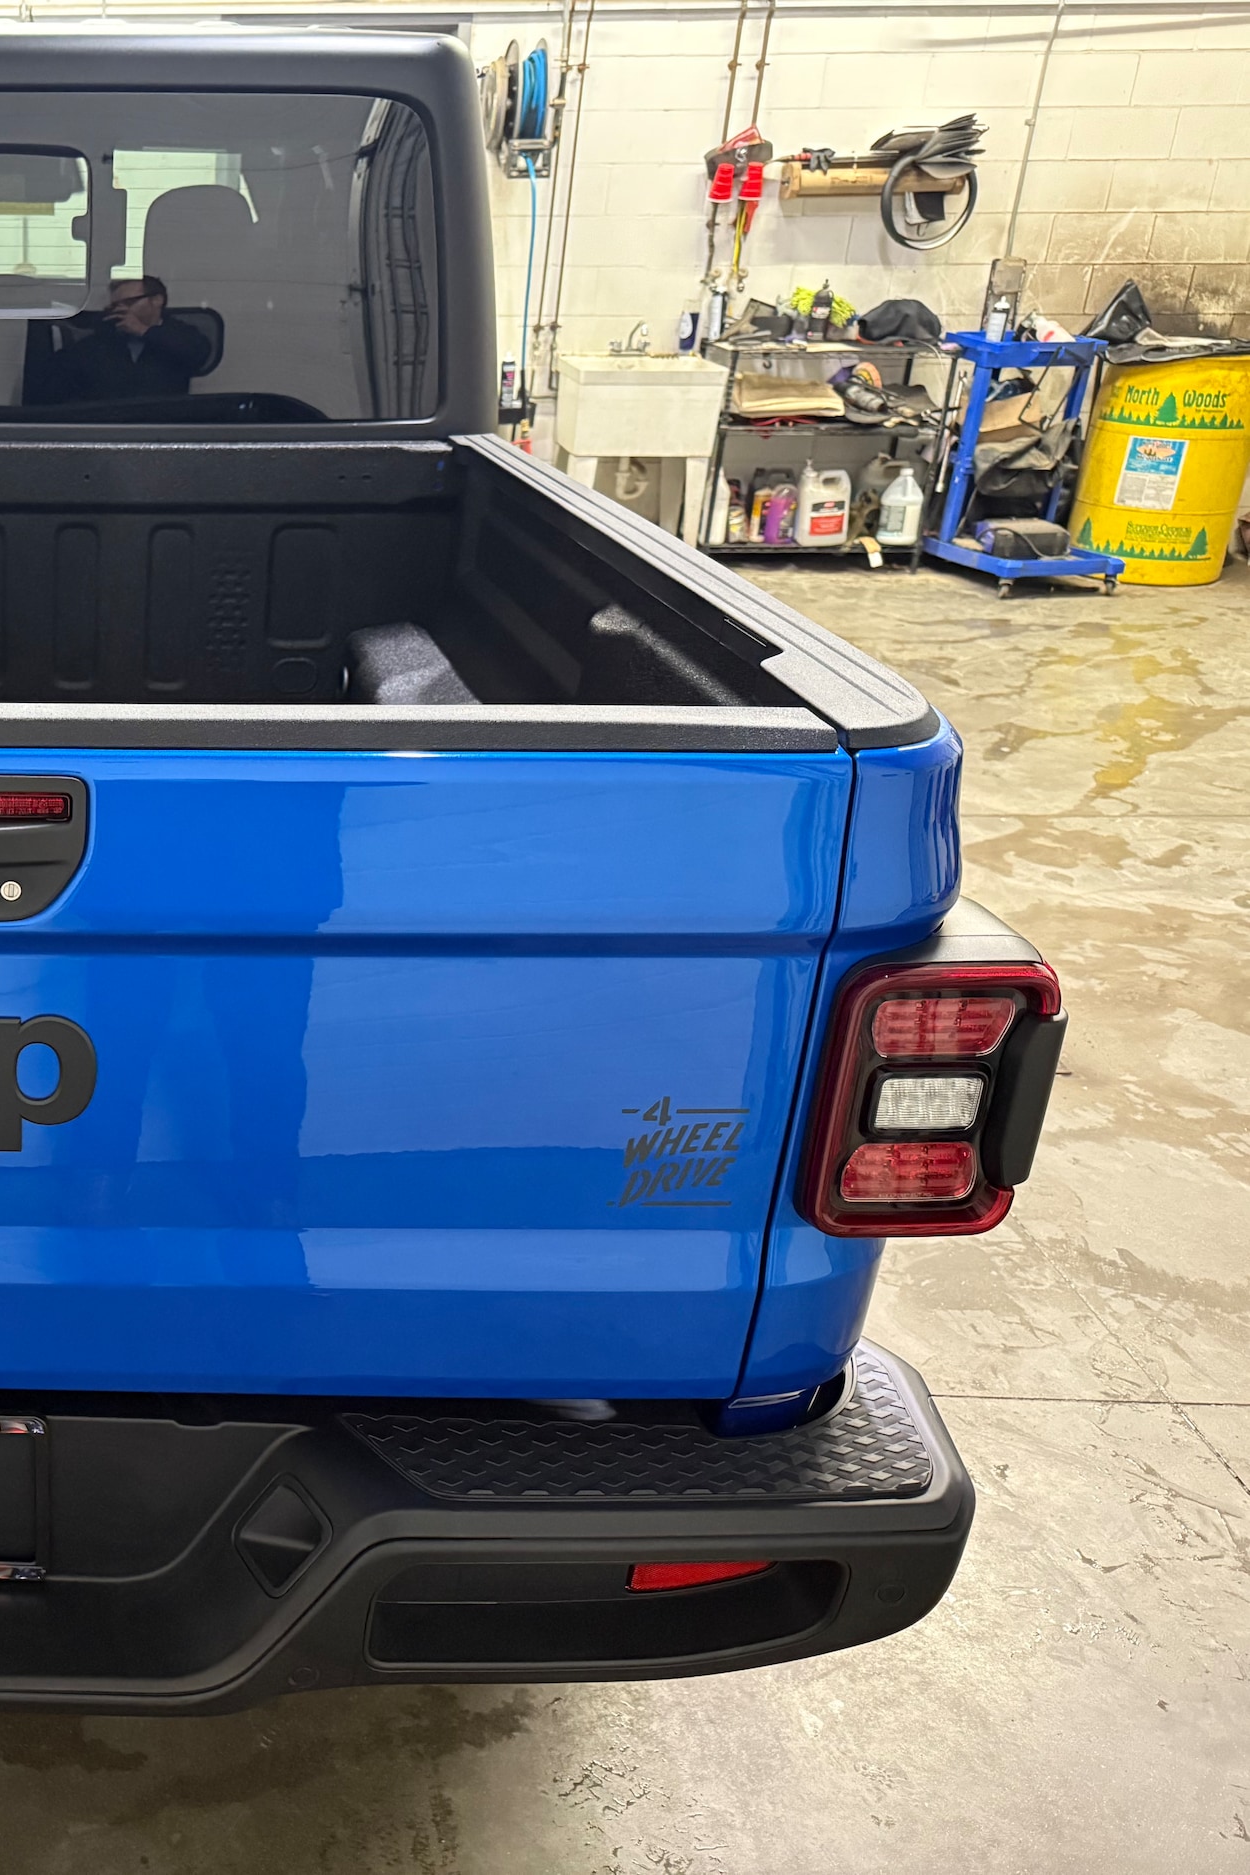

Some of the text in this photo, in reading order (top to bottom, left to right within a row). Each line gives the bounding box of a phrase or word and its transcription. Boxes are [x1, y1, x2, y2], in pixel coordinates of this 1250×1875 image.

[1125, 385, 1159, 405] North
[1183, 390, 1227, 408] Woods
[642, 1096, 671, 1126] 4
[623, 1122, 744, 1168] WHEEL
[619, 1157, 736, 1208] DRIVE
